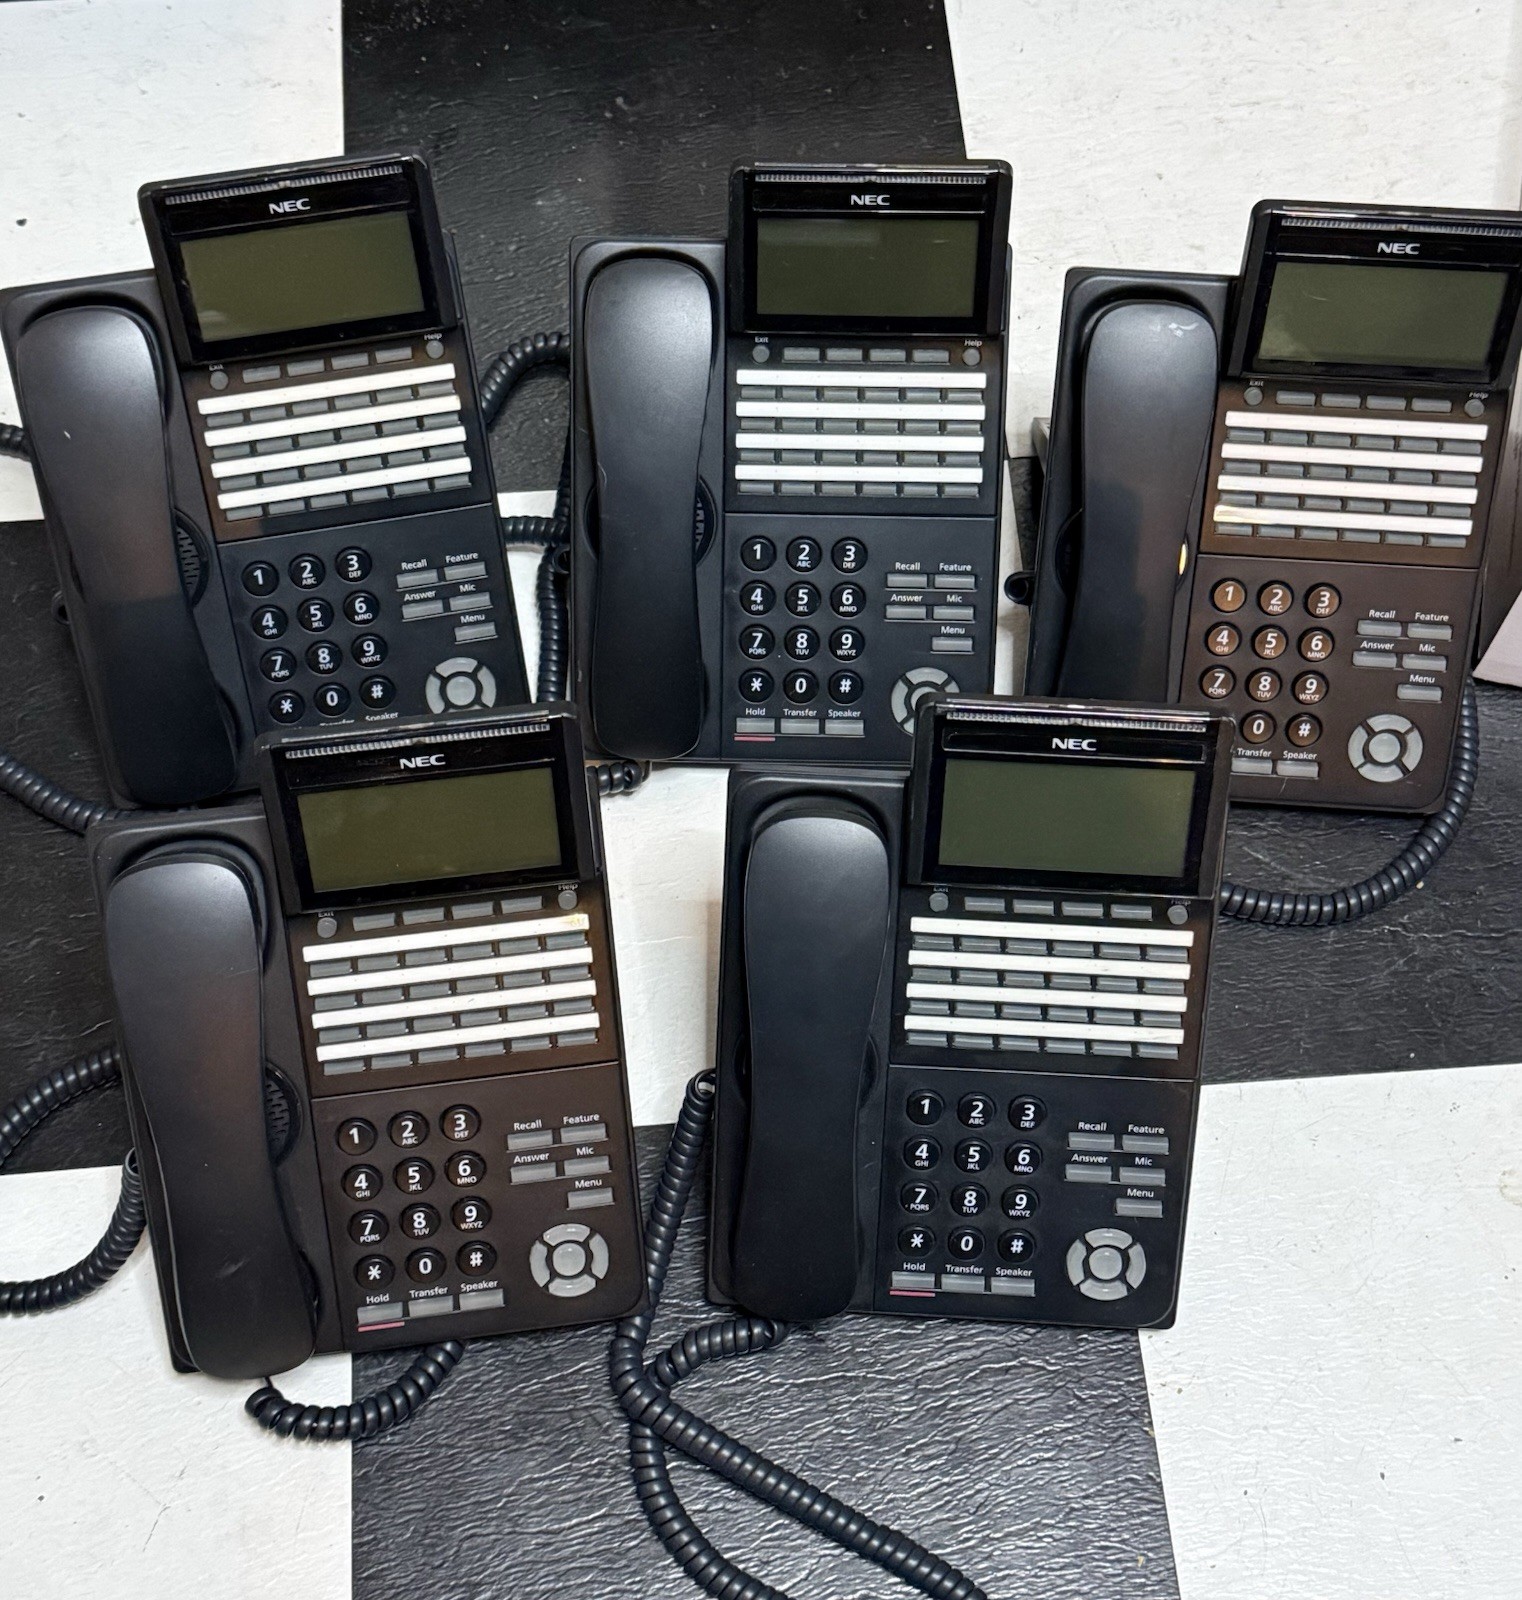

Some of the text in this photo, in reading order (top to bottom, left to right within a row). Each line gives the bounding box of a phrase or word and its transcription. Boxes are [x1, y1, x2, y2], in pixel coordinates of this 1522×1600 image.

[269, 198, 311, 214] NEC
[851, 195, 890, 206] NEC
[1377, 242, 1420, 254] NEC
[446, 552, 478, 563] Feature
[753, 544, 762, 559] 1
[799, 544, 809, 560] 2
[845, 546, 855, 561] 3
[300, 562, 313, 578] 2
[347, 556, 358, 570] 3
[402, 559, 427, 570] Recall
[896, 562, 920, 570] Recall
[939, 563, 971, 571] Feature
[254, 570, 263, 585] 1
[348, 570, 362, 578] DEF
[302, 578, 317, 586] ABC
[460, 584, 476, 592] Mic
[404, 590, 436, 601] Answer
[751, 589, 762, 603] 4
[798, 589, 808, 604] 5
[842, 590, 853, 604] 6
[891, 594, 923, 602] Answer
[947, 594, 962, 602] Mic
[1225, 586, 1233, 601] 1
[1272, 590, 1283, 604] 2
[1319, 592, 1330, 607] 3
[310, 605, 321, 620] 5
[354, 598, 366, 613] 6
[262, 612, 274, 628] 4
[354, 613, 373, 621] MNO
[460, 614, 485, 623] Menu
[1369, 610, 1395, 619] Recall
[1415, 613, 1449, 622] Feature
[312, 620, 324, 628] JKL
[941, 626, 965, 634] Menu
[264, 628, 278, 636] GHI
[1217, 630, 1228, 645] 4
[753, 633, 762, 648] 7
[797, 633, 808, 648] 8
[842, 634, 852, 649] 9
[1266, 633, 1277, 648] 5
[1311, 635, 1322, 651] 6
[1361, 641, 1394, 650] Answer
[362, 641, 374, 656] 9
[1419, 644, 1436, 652] Mic
[318, 648, 330, 664] 8
[361, 655, 381, 664] WXYZ
[272, 656, 282, 671] 7
[319, 662, 334, 670] TUV
[271, 670, 290, 678] PQRS
[1214, 673, 1224, 688] 7
[1410, 675, 1435, 683] Menu
[795, 678, 806, 693] 0
[840, 679, 851, 692] #
[1259, 676, 1270, 691] 8
[1306, 679, 1317, 694] 9
[326, 690, 338, 706] 0
[371, 684, 383, 698] #
[746, 708, 766, 716] Hold
[828, 709, 860, 718] Speaker
[1253, 720, 1264, 734] 0
[1298, 722, 1310, 736] #
[1052, 738, 1096, 750] NEC
[1237, 748, 1271, 757] Transfer
[1283, 751, 1317, 760] Speaker
[400, 754, 446, 769] NEC
[921, 1099, 930, 1115] 1
[971, 1102, 983, 1117] 2
[1022, 1104, 1035, 1120] 3
[454, 1114, 466, 1131] 3
[514, 1120, 542, 1131] Recall
[564, 1113, 600, 1124] Feature
[402, 1121, 414, 1138] 2
[454, 1130, 468, 1138] DEF
[1078, 1122, 1107, 1132] Recall
[1128, 1125, 1164, 1134] Feature
[350, 1128, 358, 1144] 1
[402, 1137, 418, 1145] ABC
[514, 1152, 549, 1164] Answer
[576, 1146, 594, 1156] Mic
[915, 1144, 928, 1159] 4
[969, 1147, 980, 1162] 5
[1018, 1149, 1030, 1165] 6
[1071, 1154, 1108, 1164] Answer
[1135, 1157, 1153, 1166] Mic
[458, 1160, 471, 1176] 6
[1014, 1165, 1033, 1173] MNO
[354, 1174, 368, 1190] 4
[408, 1168, 420, 1184] 5
[458, 1176, 477, 1184] MNO
[575, 1178, 602, 1188] Menu
[356, 1190, 370, 1198] GHI
[914, 1189, 926, 1204] 7
[964, 1191, 977, 1206] 8
[1127, 1188, 1154, 1198] Menu
[1015, 1194, 1027, 1209] 9
[413, 1213, 426, 1228] 8
[464, 1206, 477, 1222] 9
[362, 1220, 374, 1235] 7
[414, 1228, 430, 1236] TUV
[461, 1221, 482, 1230] WXYZ
[360, 1234, 380, 1242] PQRS
[960, 1237, 974, 1251] 0
[1010, 1239, 1024, 1253] #
[419, 1258, 431, 1274] 0
[470, 1252, 482, 1266] #
[903, 1262, 926, 1270] Hold
[945, 1265, 983, 1274] Transfer
[995, 1267, 1032, 1277] Speaker
[409, 1286, 448, 1298] Transfer
[460, 1280, 498, 1292] Speaker
[366, 1294, 389, 1304] Hold
